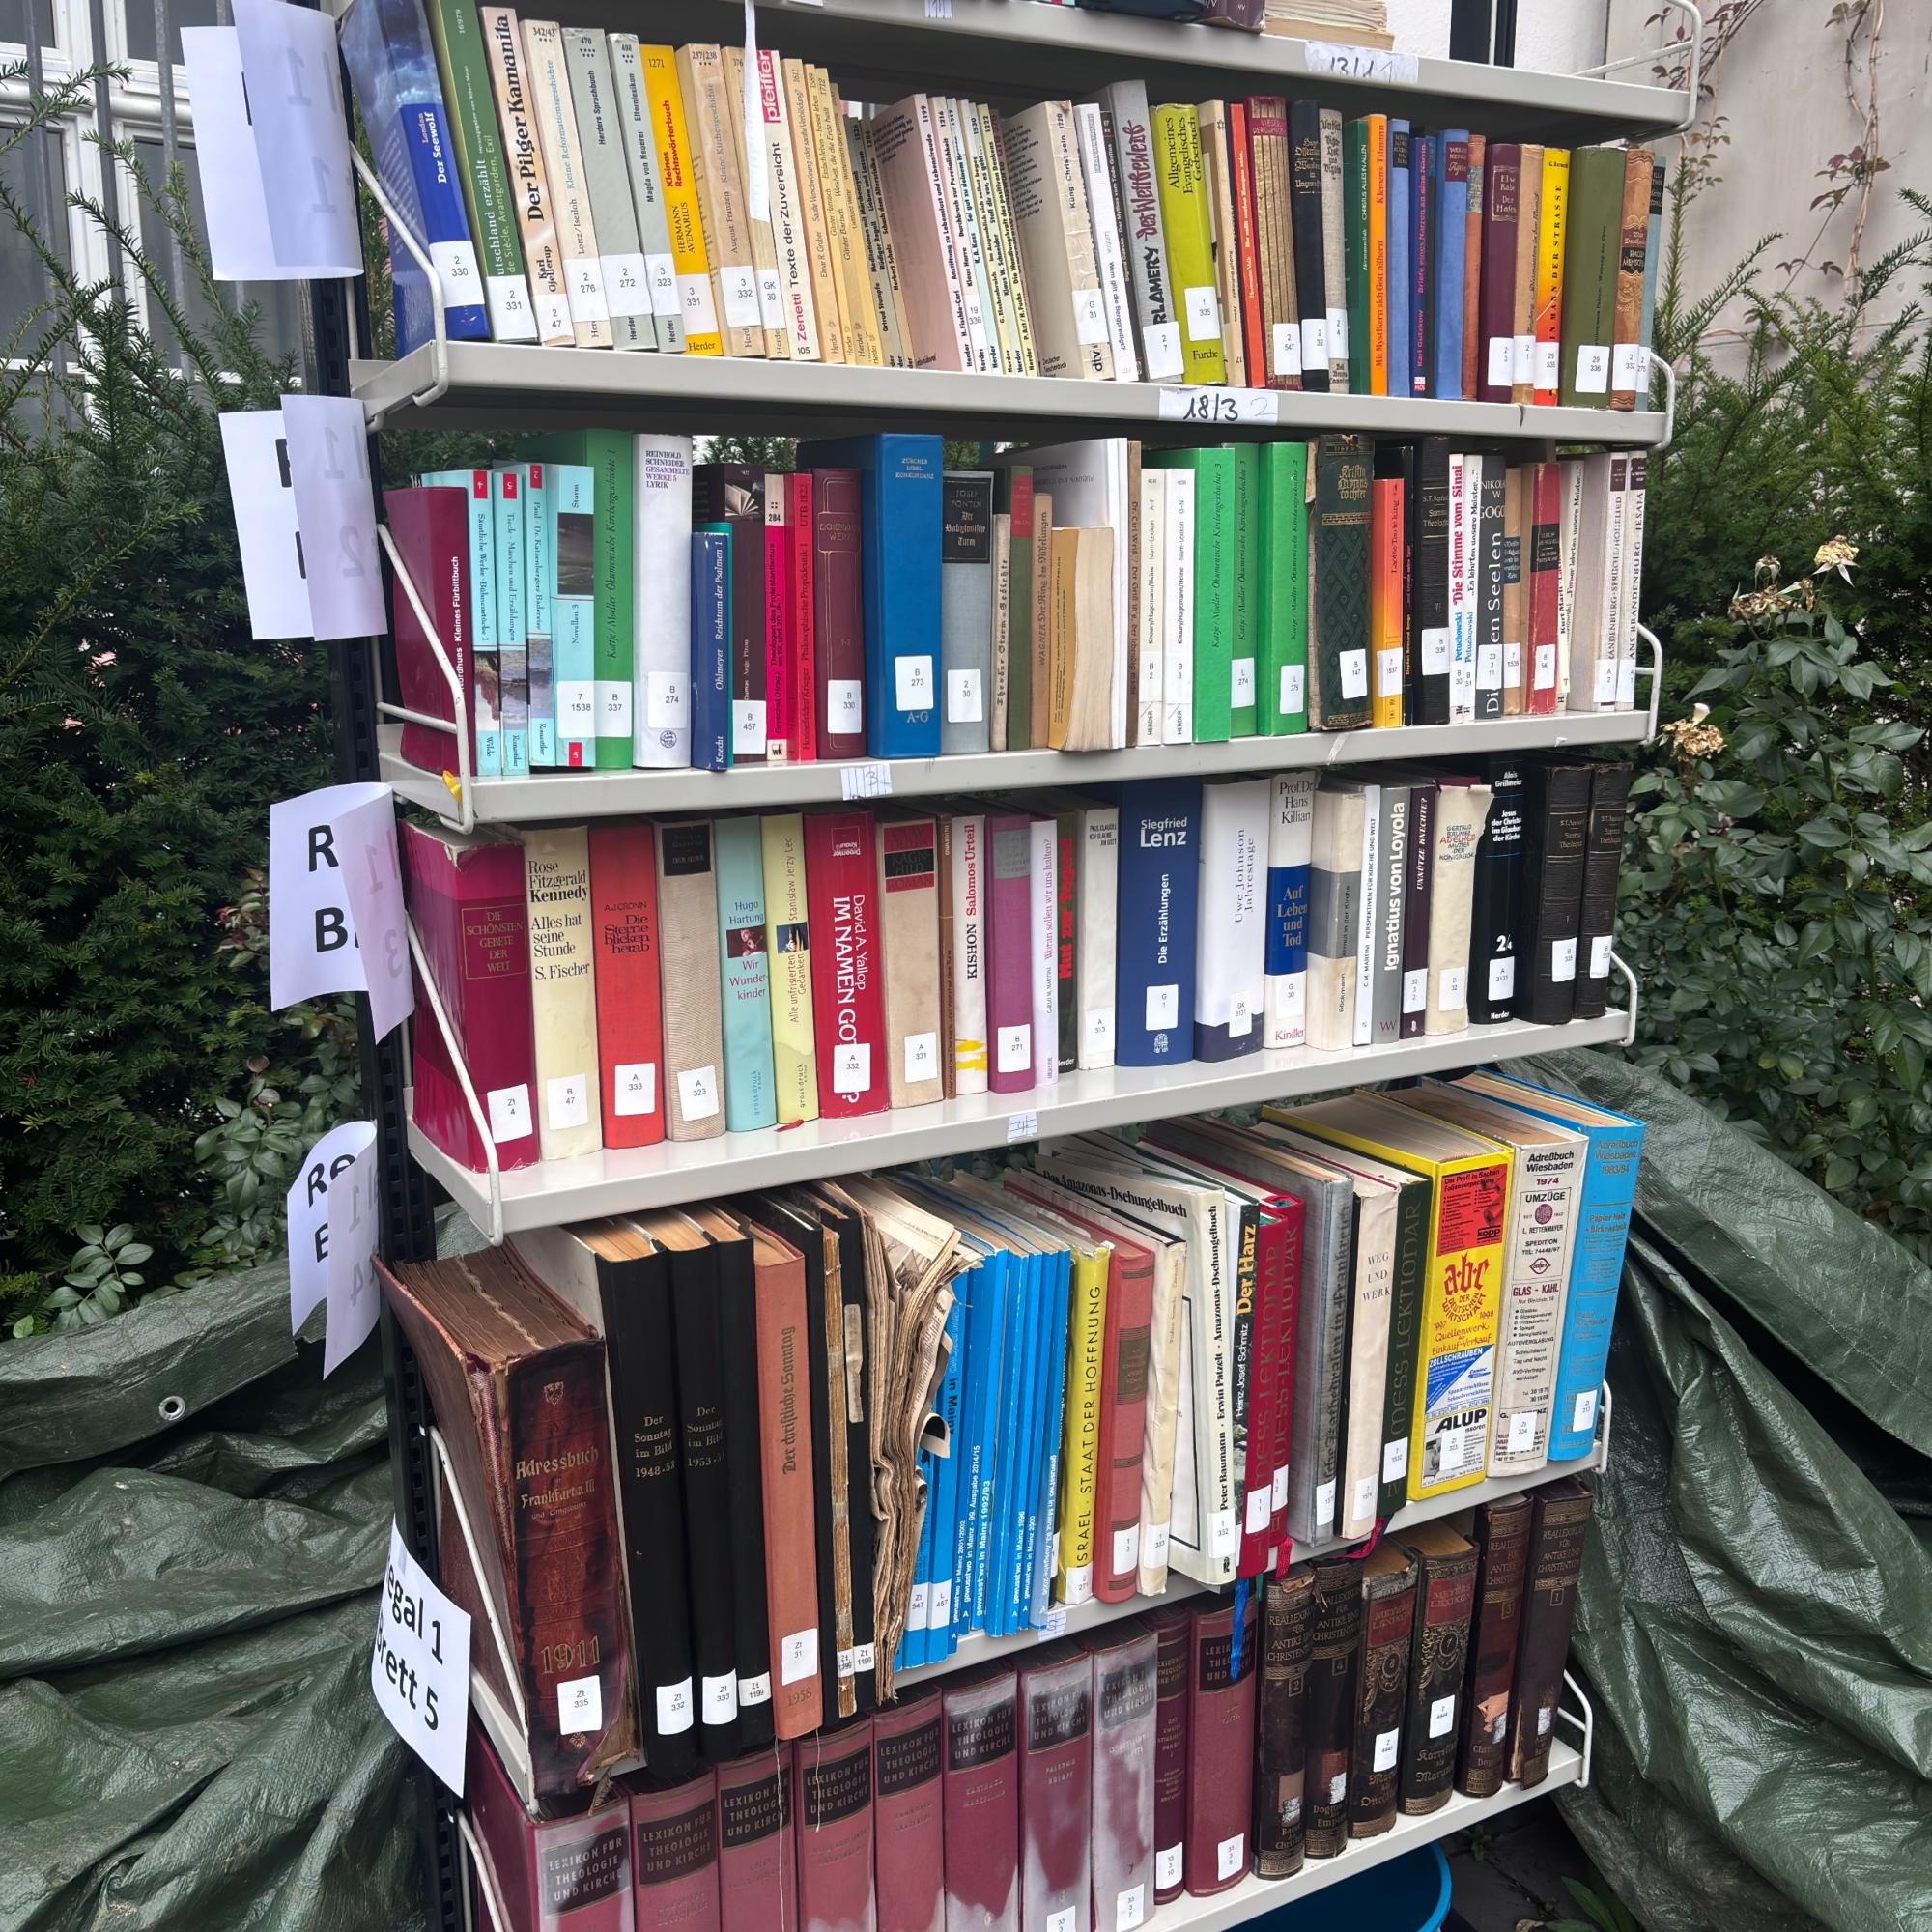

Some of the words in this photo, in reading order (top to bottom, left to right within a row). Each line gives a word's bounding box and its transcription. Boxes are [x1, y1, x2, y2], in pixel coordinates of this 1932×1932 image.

[496, 15, 526, 114] Kamanita
[588, 70, 602, 113] Sprachbuch
[759, 51, 780, 123] pfeiffer
[548, 60, 571, 160] Reformationsgeschichte
[419, 113, 429, 143] London
[424, 112, 443, 158] Seewolf
[596, 116, 606, 145] Herders
[513, 116, 537, 181] Pilger
[662, 100, 682, 187] Rechtswörterbuch
[1165, 117, 1179, 189] Allgemeines
[1179, 117, 1194, 194] Evangelisches
[1190, 116, 1204, 182] Gebetbuch
[438, 163, 447, 184] Der
[662, 151, 672, 187] Kleines
[773, 142, 791, 217] Zuversicht
[527, 182, 544, 222] Der
[671, 205, 685, 253] HERMANN
[681, 202, 696, 253] AVENARIUS
[783, 220, 793, 243] der
[452, 268, 469, 276] 330
[537, 258, 547, 278] Karl
[544, 246, 556, 292] Gjellerup
[787, 245, 800, 288] Texte
[620, 278, 635, 287] 272
[794, 293, 809, 341] Zenetti
[688, 341, 716, 351] Herder
[1192, 349, 1218, 359] Furche
[646, 458, 685, 467] SCHNEIDER
[646, 467, 689, 475] GESAMMELTE
[1453, 465, 1463, 498] Sinai
[1453, 502, 1463, 530] vom
[715, 549, 724, 582] Psalmen
[1453, 533, 1463, 579] Stimme
[451, 556, 461, 606] Fürbittbuch
[1488, 532, 1501, 610] Seelen
[715, 584, 724, 599] der
[715, 600, 724, 639] Reichtum
[714, 649, 724, 690] Ohlmeyer
[1285, 795, 1308, 808] Hans
[1141, 817, 1187, 831] Siegfried
[1282, 811, 1311, 823] Killian
[965, 824, 975, 860] Urteil
[1140, 830, 1186, 847] Lenz
[1390, 802, 1405, 862] Loyola
[528, 860, 558, 874] Rose
[1236, 829, 1245, 891] Johnson
[529, 870, 586, 890] Fitzgerald
[966, 860, 977, 918] Salomos
[1245, 838, 1254, 912] Jahrestage
[1390, 864, 1401, 895] von
[530, 887, 588, 903] Kennedy
[735, 900, 759, 911] Hugo
[1284, 886, 1303, 898] Auf
[487, 911, 503, 921] DIE
[531, 915, 562, 930] Alles
[564, 913, 582, 927] hat
[626, 915, 648, 925] Die
[729, 911, 764, 925] Hartung
[833, 896, 851, 922] IM
[853, 895, 866, 934] David
[1158, 874, 1170, 943] Erzählungen
[1235, 895, 1243, 923] Uwe
[1277, 903, 1308, 917] Leben
[467, 922, 523, 935] SCHÖNSTEN
[534, 931, 564, 944] seine
[604, 935, 648, 945] blicken
[605, 924, 648, 935] Sterne
[1283, 932, 1301, 946] Tod
[1284, 920, 1302, 931] und
[1384, 897, 1401, 970] Ignatius
[480, 935, 514, 948] GEBETE
[490, 949, 507, 959] DER
[534, 942, 576, 958] Stunde
[611, 943, 649, 953] herab
[967, 924, 978, 980] KISHON
[1158, 947, 1168, 964] Die
[487, 960, 510, 973] WELT
[535, 966, 547, 980] S.
[549, 962, 590, 980] Fischer
[742, 960, 758, 971] Wir
[797, 953, 806, 995] Gedanken
[836, 925, 855, 1004] NAMEN
[856, 952, 867, 991] Yallop
[729, 974, 767, 986] Wunder-
[737, 987, 765, 1001] kinder
[789, 955, 798, 1004] unfrisierten
[1275, 1029, 1304, 1040] Kindler
[694, 1088, 707, 1096] 323
[1527, 1161, 1573, 1172] Wiesbaden
[1528, 1151, 1574, 1162] Adreßbuch
[1062, 1178, 1187, 1217] Amazonas-Dschungelbuch
[1526, 1192, 1565, 1203] UMZÜGE
[1238, 1223, 1255, 1278] Harz
[1368, 1252, 1389, 1265] WEG
[1209, 1205, 1223, 1341] Amazonas-Dschungelbuch
[1368, 1269, 1387, 1283] UND
[1236, 1282, 1252, 1317] Der
[1362, 1288, 1390, 1301] WERK
[1513, 1286, 1531, 1296] GLAS
[1542, 1283, 1559, 1293] KAHL
[781, 1326, 795, 1382] Sonntag
[1086, 1286, 1101, 1393] HOFFNUNG
[1239, 1323, 1250, 1359] Schmitz
[1215, 1352, 1224, 1387] Patzelt
[1084, 1400, 1095, 1433] DER
[1215, 1391, 1225, 1420] Erwin
[644, 1415, 663, 1427] Der
[1435, 1409, 1487, 1434] ALUP
[634, 1428, 671, 1444] Sonntag
[635, 1449, 650, 1458] im
[654, 1442, 672, 1457] Bild
[516, 1447, 598, 1481] Adressbuch
[783, 1447, 797, 1474] Der
[1082, 1441, 1094, 1493] STAAT
[1219, 1480, 1229, 1510] Peter
[1077, 1510, 1090, 1567] ISRAEL
[387, 1554, 423, 1639] egal
[432, 1620, 442, 1664] 1
[542, 1635, 601, 1674] 1911
[425, 1686, 438, 1730] 5
[549, 1849, 599, 1872] LEXIKON
[555, 1856, 619, 1886] THEOLOGIE
[554, 1885, 578, 1901] UND
[583, 1869, 622, 1892] KIRCHE
